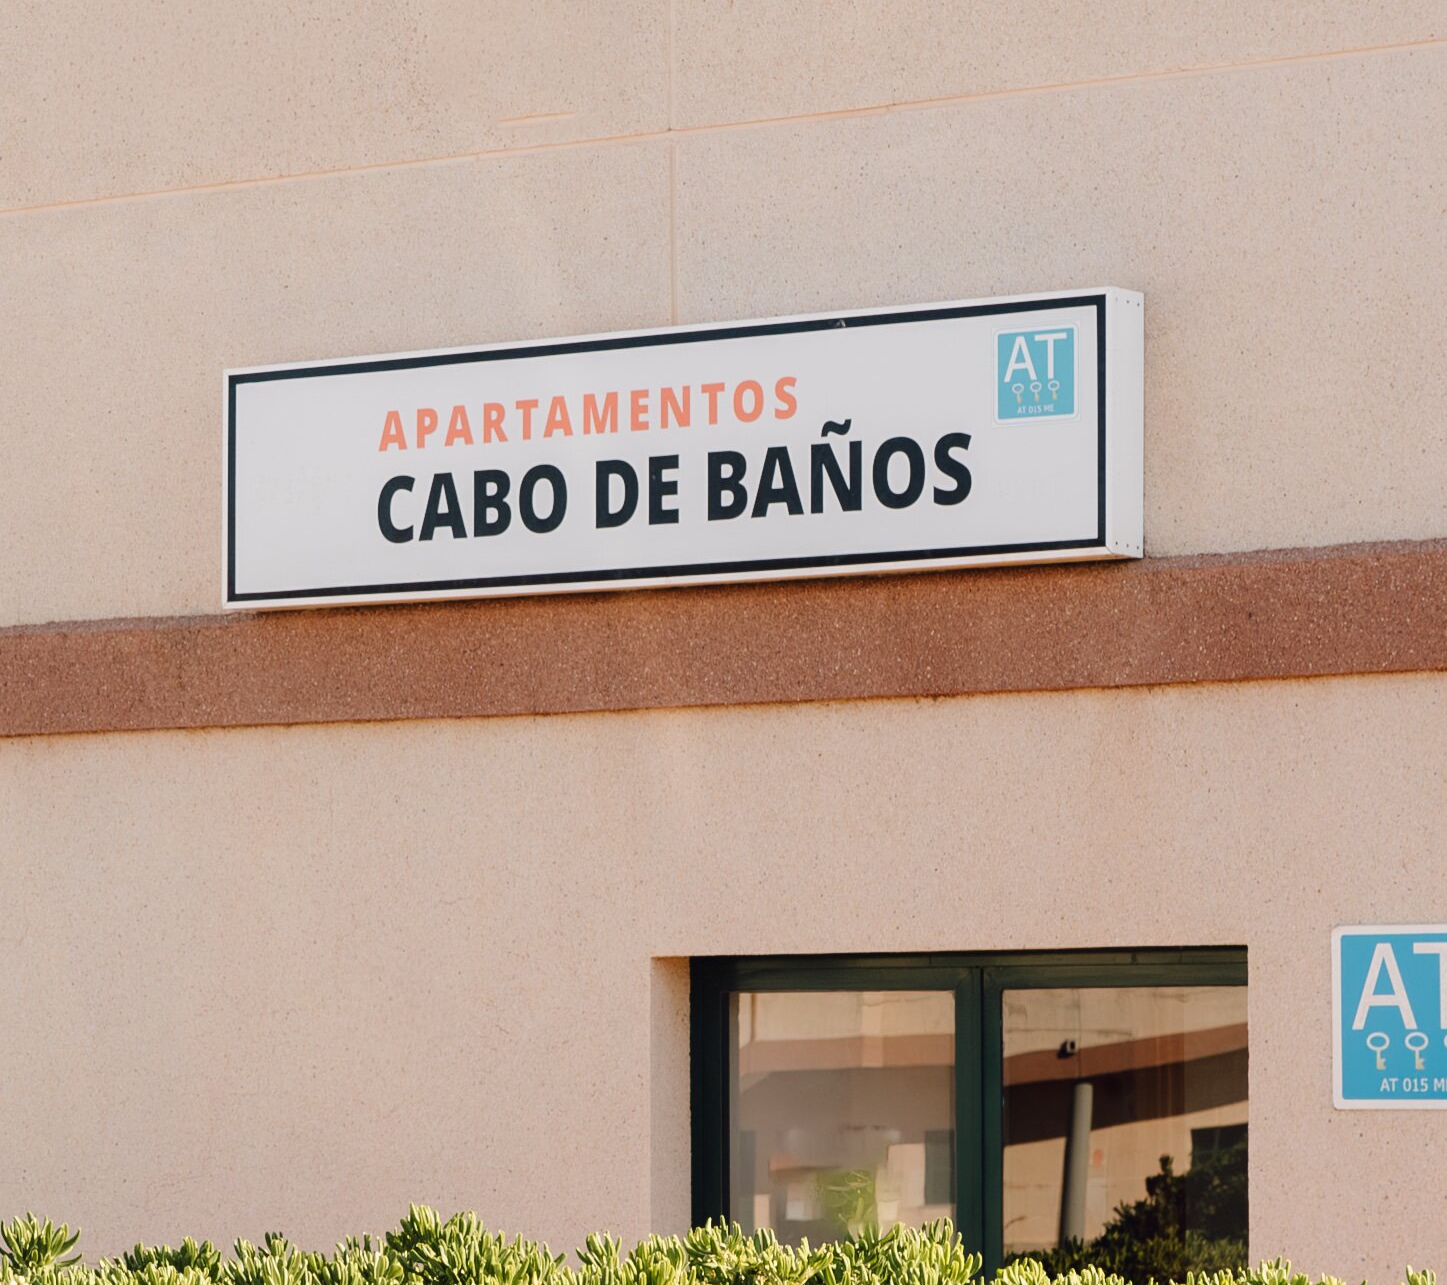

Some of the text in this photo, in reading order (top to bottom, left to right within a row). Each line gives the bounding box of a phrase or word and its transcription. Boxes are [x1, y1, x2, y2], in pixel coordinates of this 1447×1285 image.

[1004, 332, 1068, 383] AT
[378, 376, 798, 453] APARTAMENTOS
[377, 418, 972, 544] CABO DE BAÑOS
[1380, 1078, 1399, 1093] AT
[1403, 1077, 1429, 1093] 015
